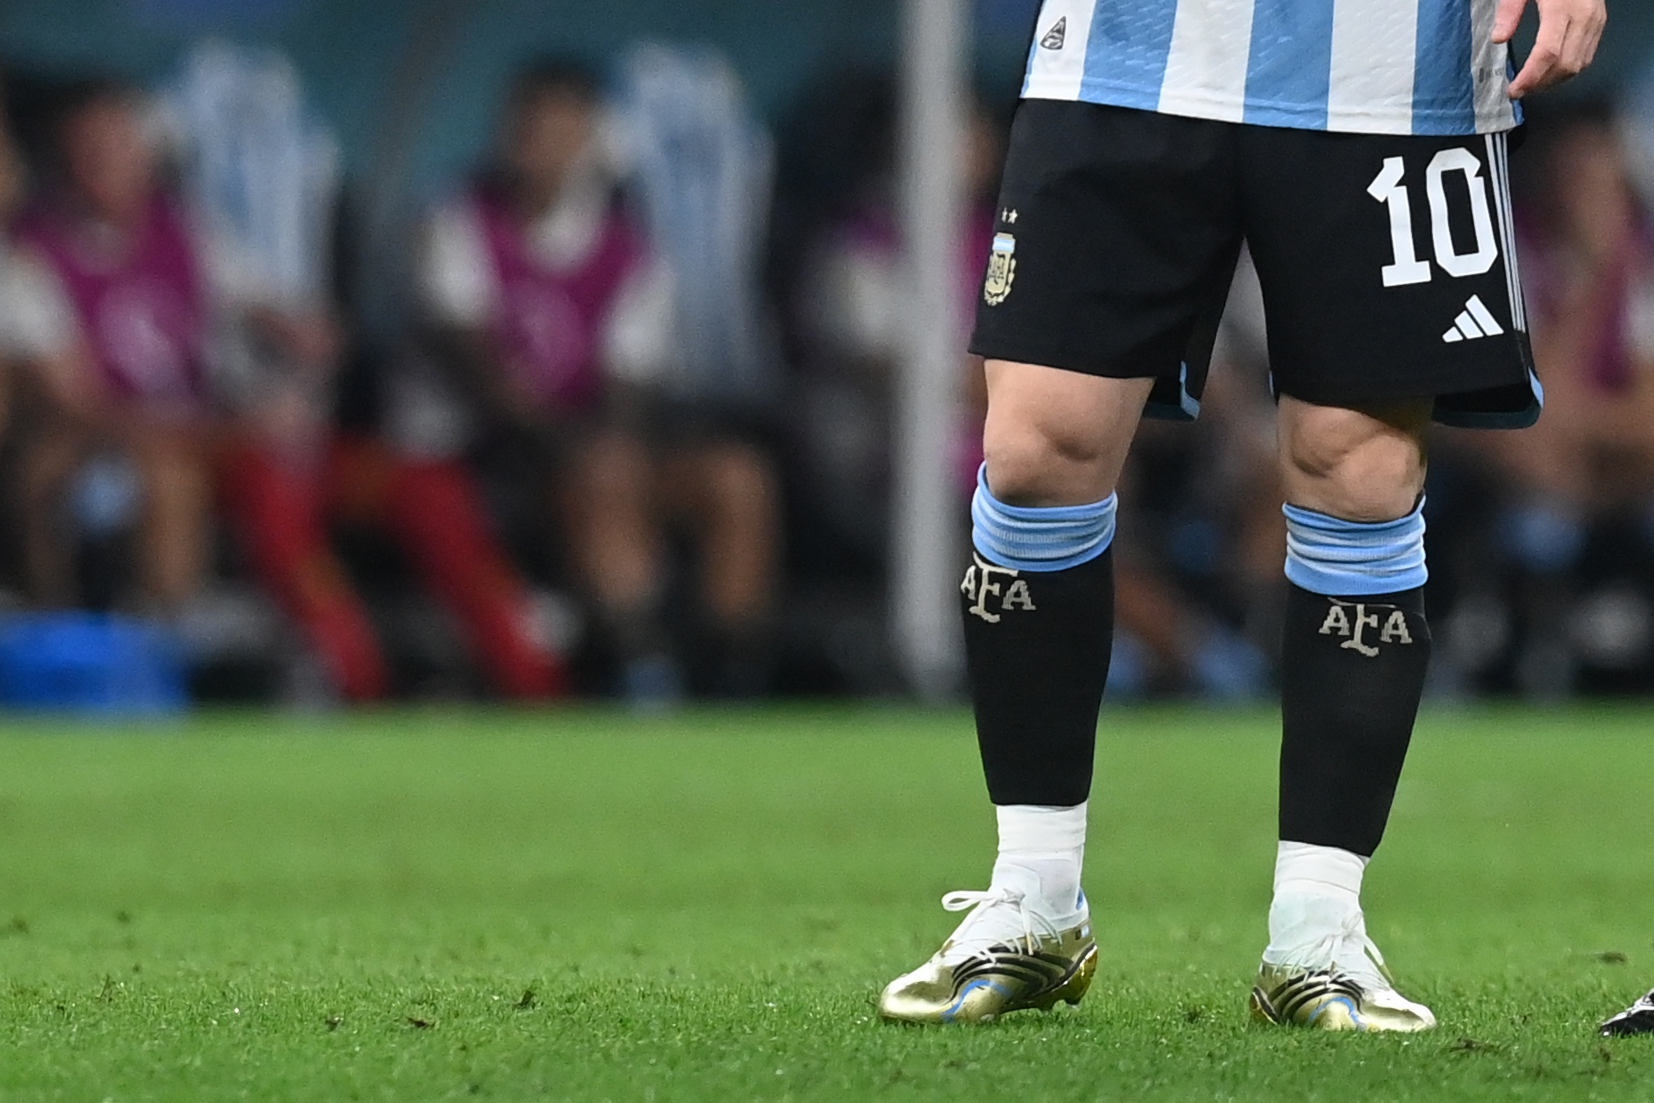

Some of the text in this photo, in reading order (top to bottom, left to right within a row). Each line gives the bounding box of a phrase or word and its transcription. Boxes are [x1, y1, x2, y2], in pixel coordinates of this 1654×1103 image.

[1366, 147, 1499, 287] 10
[960, 551, 1036, 623] AFA
[1318, 597, 1413, 657] AFA
